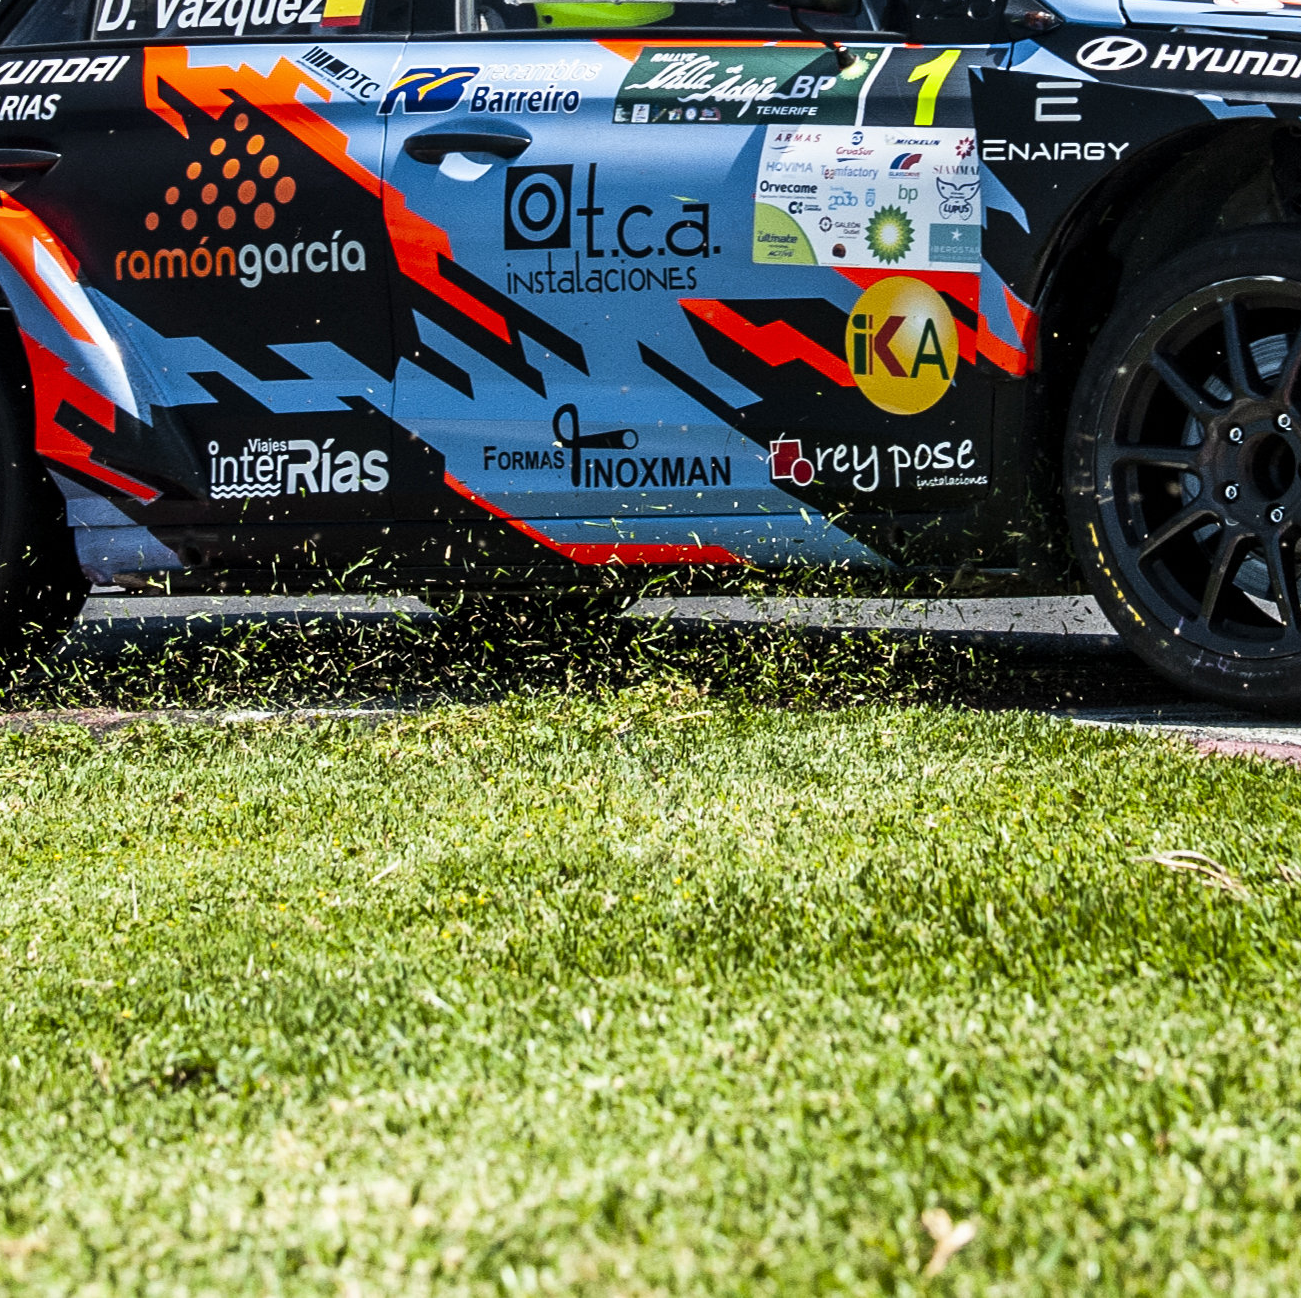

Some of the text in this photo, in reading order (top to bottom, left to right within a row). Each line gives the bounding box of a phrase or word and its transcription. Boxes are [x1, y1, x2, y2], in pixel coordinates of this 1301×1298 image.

[650, 52, 698, 63] RALLYE
[479, 58, 602, 83] recambios
[337, 68, 380, 99] PTC
[790, 75, 837, 99] BP
[908, 49, 962, 125] 1
[469, 84, 581, 114] Barreiro
[756, 105, 818, 116] TENERIFE
[774, 133, 822, 143] ARMAS
[893, 138, 941, 146] MICHELIN
[982, 139, 1130, 161] ENAIRGY
[765, 161, 814, 173] HOVIMA
[821, 165, 880, 180] Teamfactory
[759, 180, 818, 193] Orvecame
[898, 184, 919, 204] bp
[943, 204, 970, 213] LUPUS
[248, 438, 288, 455] Viajes
[916, 473, 988, 488] instalaciones
